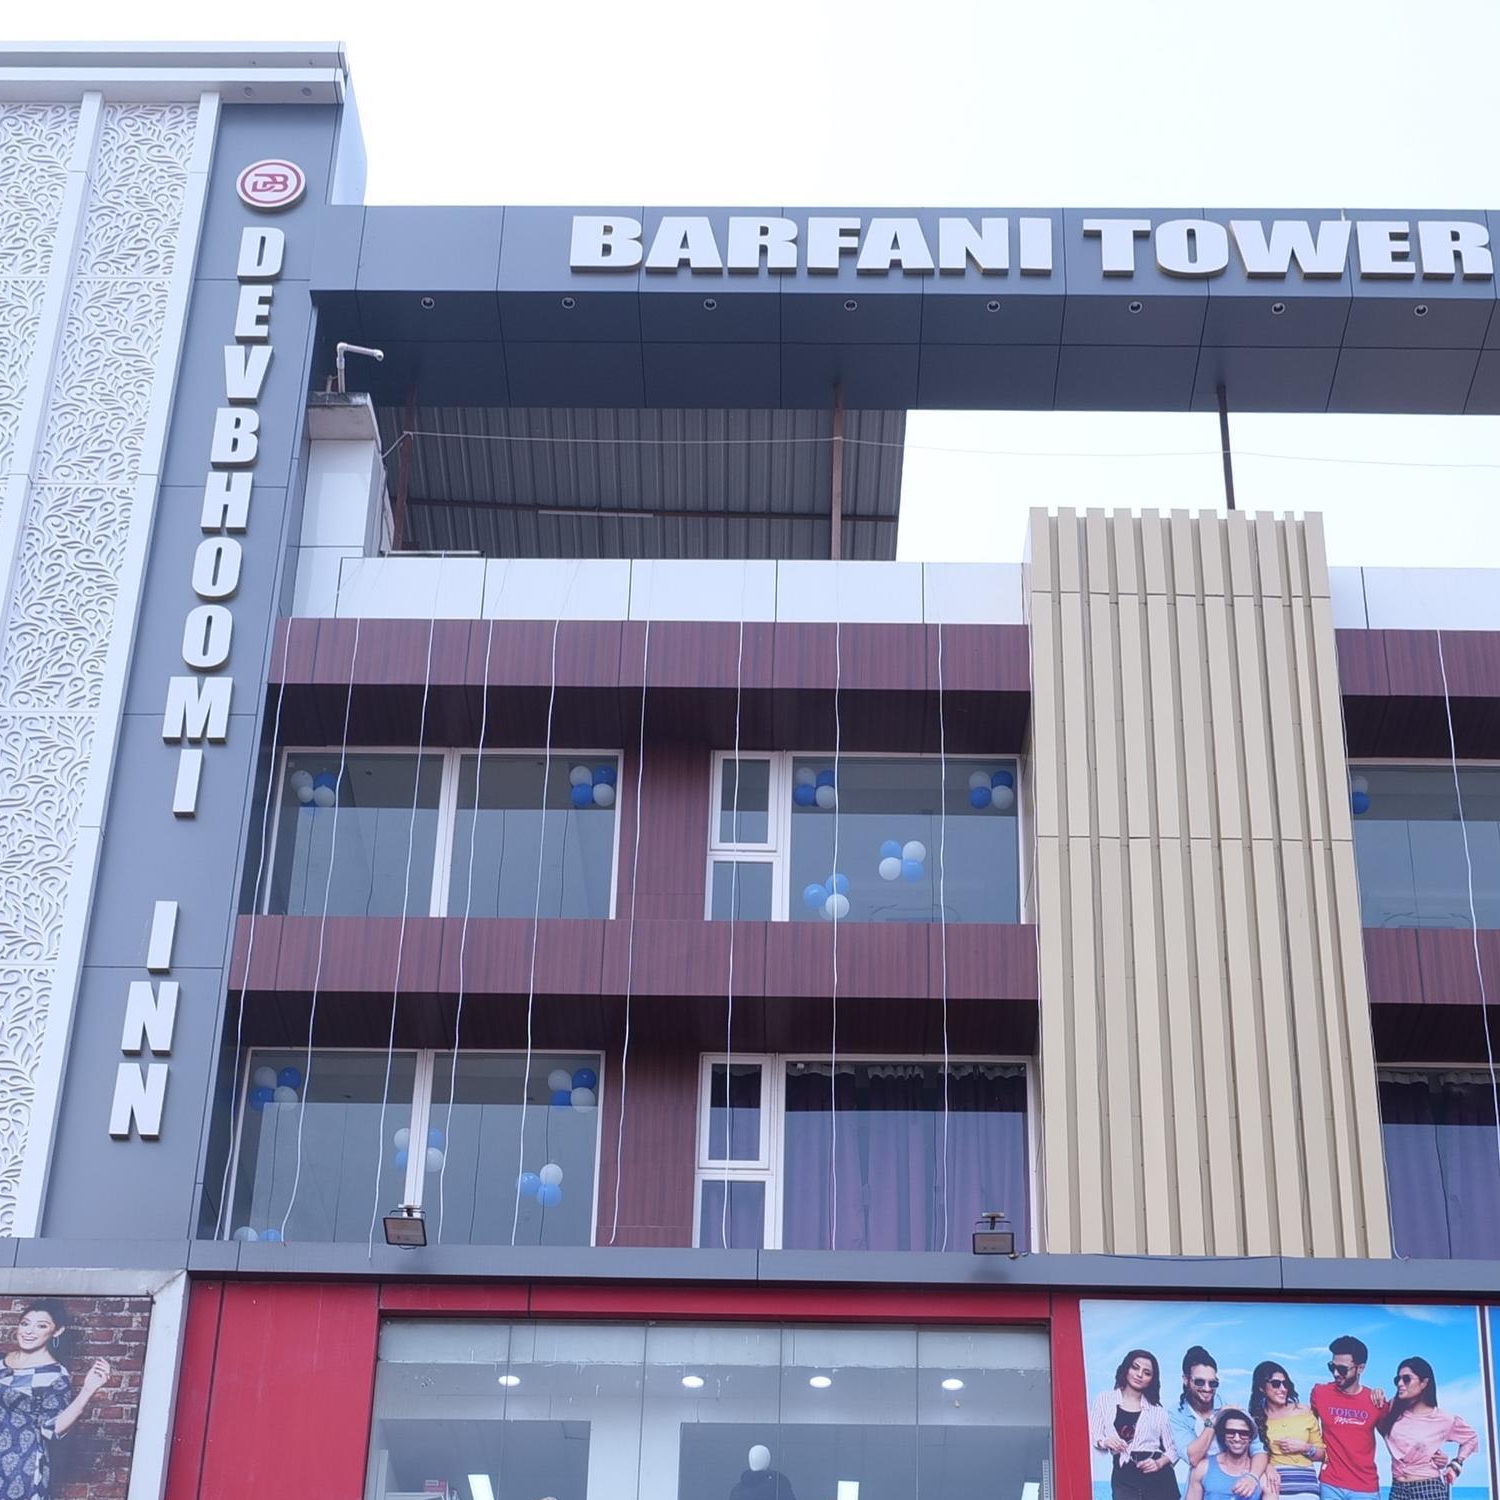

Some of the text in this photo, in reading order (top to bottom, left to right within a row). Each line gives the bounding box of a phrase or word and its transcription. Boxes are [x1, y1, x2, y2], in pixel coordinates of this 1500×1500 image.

[570, 215, 1493, 280] BARFANI TOWER
[109, 227, 285, 1141] DEVBHOOMI INN
[1329, 1407, 1369, 1420] TOKYO
